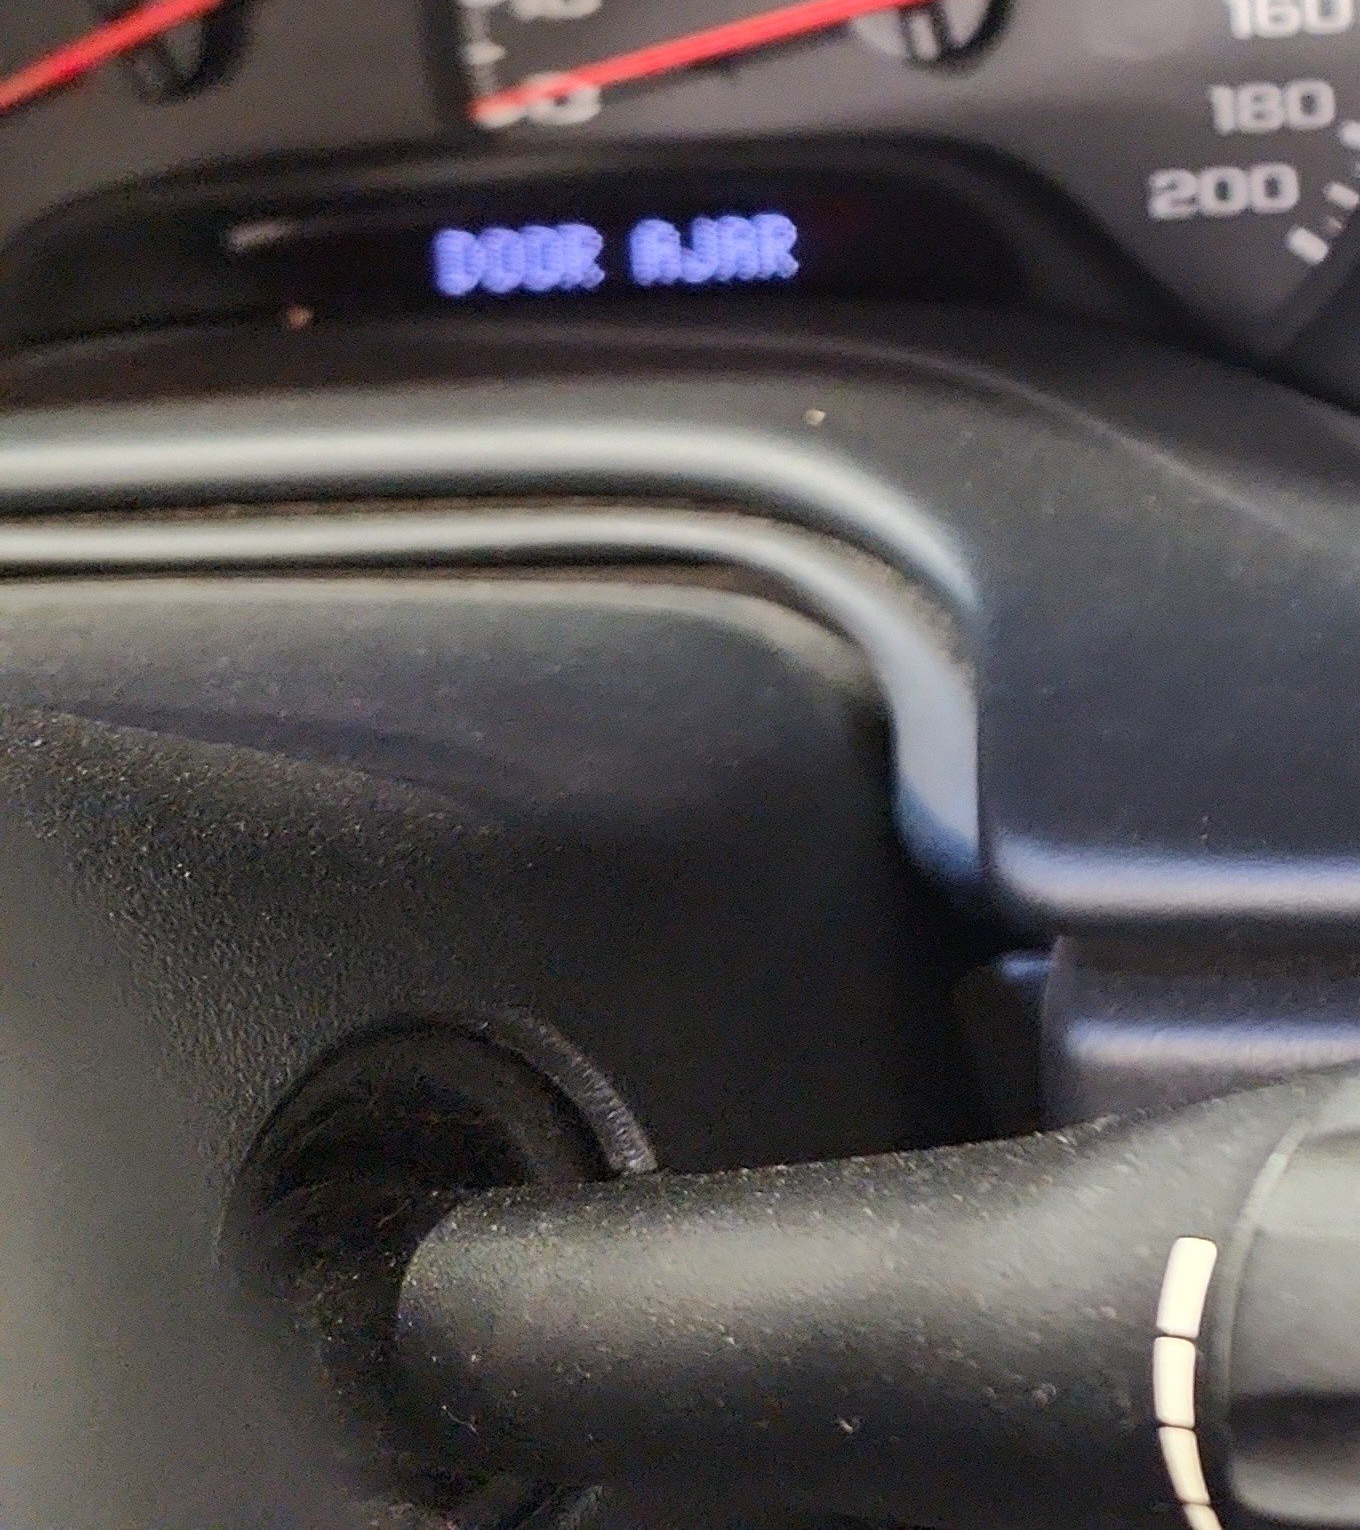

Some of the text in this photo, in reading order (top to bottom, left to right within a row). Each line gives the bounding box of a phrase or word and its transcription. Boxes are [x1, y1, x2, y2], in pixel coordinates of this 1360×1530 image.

[1209, 78, 1337, 133] 180
[1149, 162, 1301, 219] 200
[433, 211, 801, 297] DOOR AJAR
